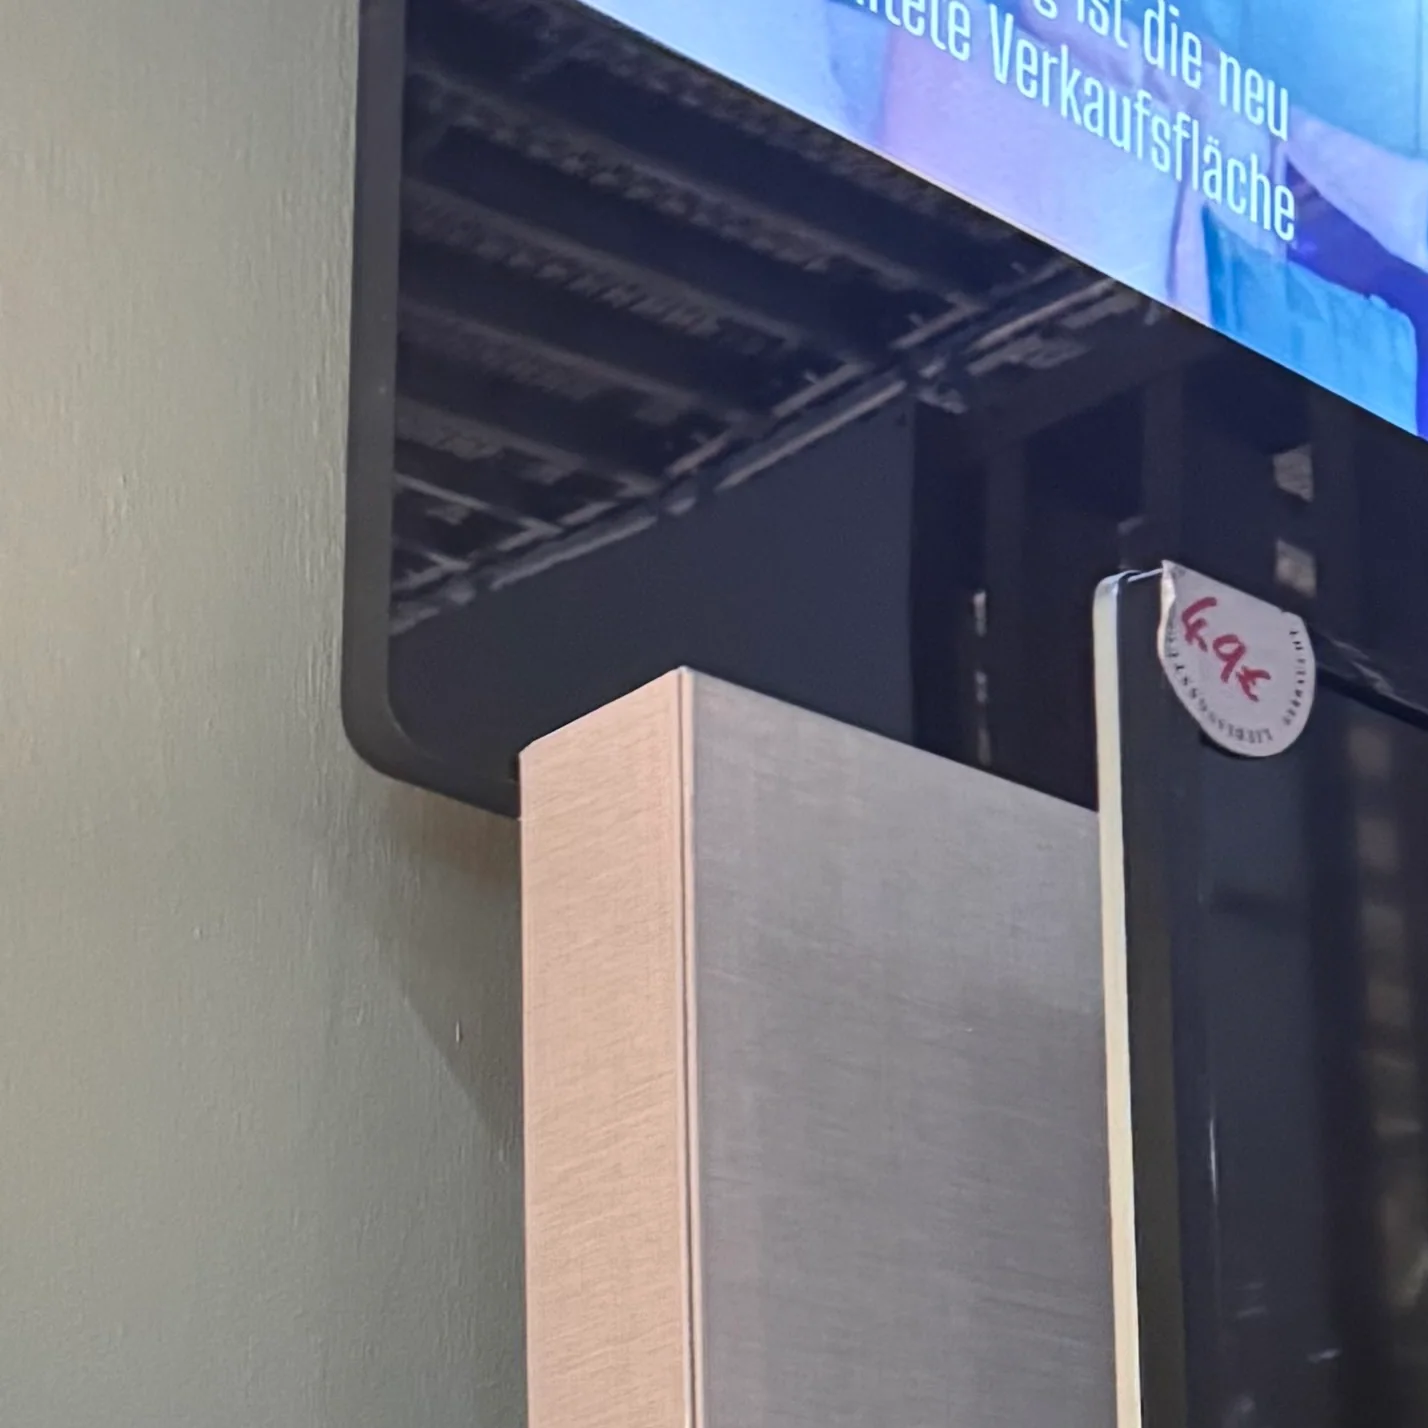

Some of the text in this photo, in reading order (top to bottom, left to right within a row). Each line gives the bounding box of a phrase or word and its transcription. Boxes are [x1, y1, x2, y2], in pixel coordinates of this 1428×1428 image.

[988, 4, 1295, 241] Verkaufsfläche
[1142, 0, 1202, 89] die
[1218, 48, 1289, 141] neu
